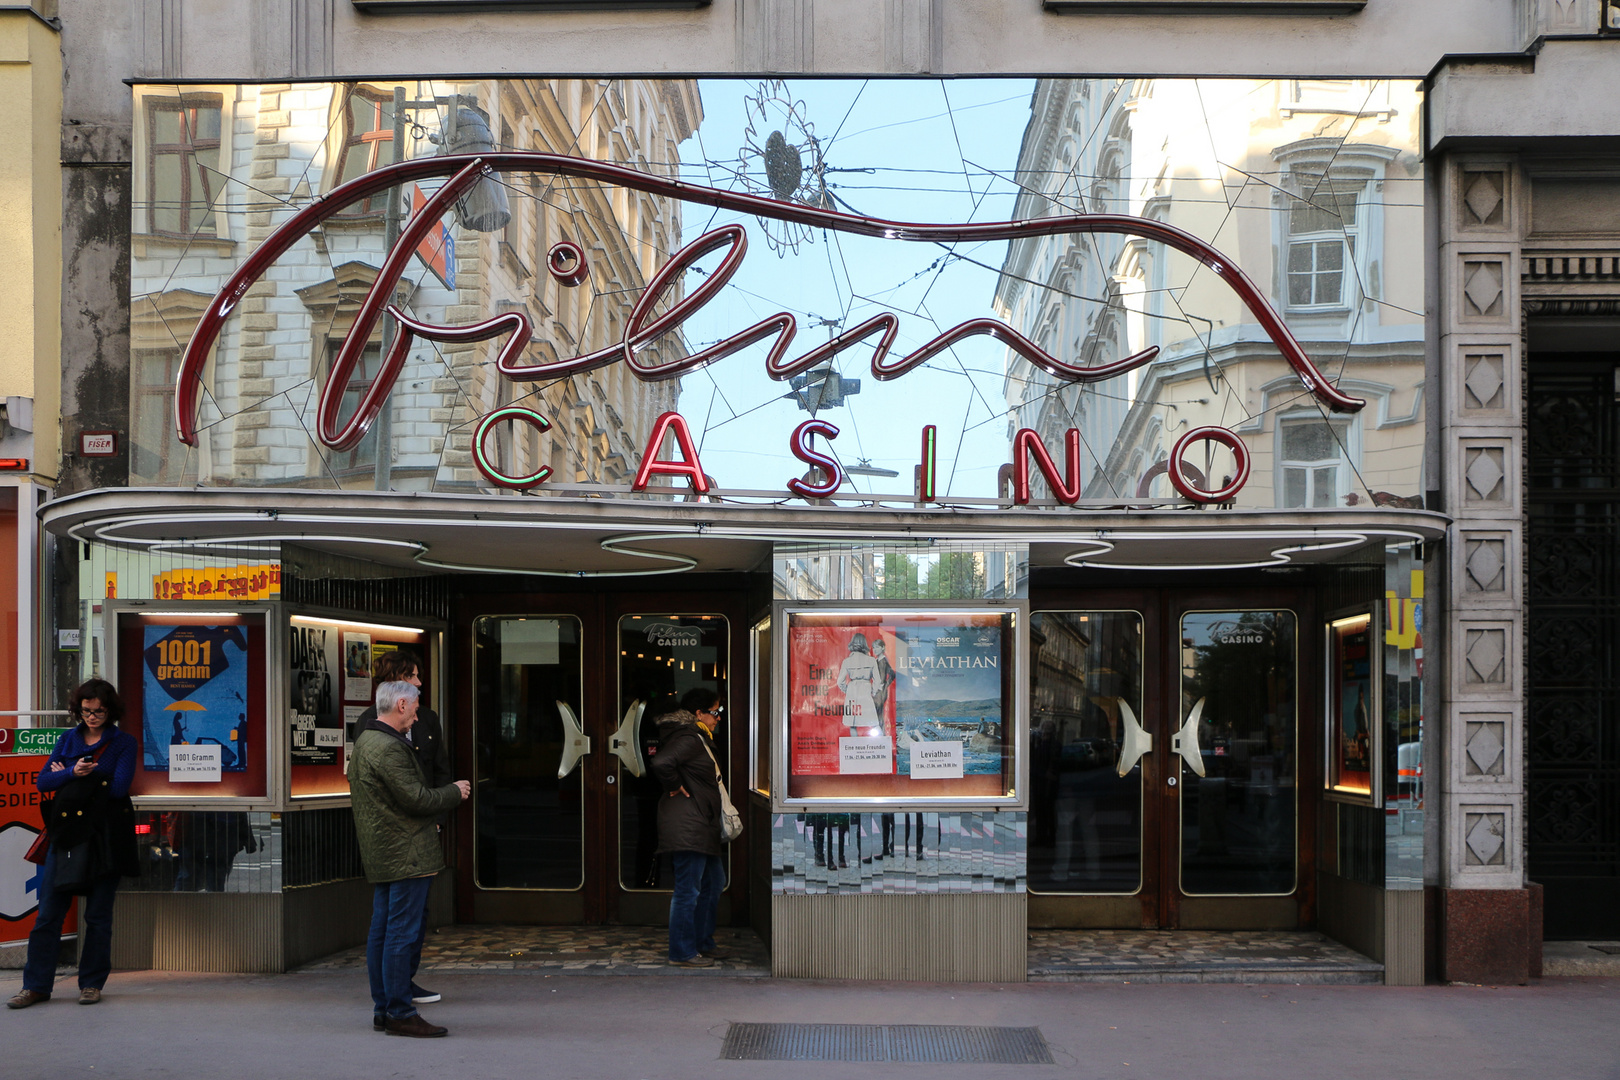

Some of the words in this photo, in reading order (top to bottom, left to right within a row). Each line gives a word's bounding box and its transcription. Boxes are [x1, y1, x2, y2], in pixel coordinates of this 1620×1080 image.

[176, 151, 1365, 448] Film
[472, 405, 1251, 506] CASINO
[657, 638, 698, 647] CASINO
[1220, 635, 1264, 644] CASINO
[156, 639, 211, 665] 1001
[898, 655, 998, 669] LEVIATHAN
[157, 665, 211, 681] gramm
[809, 664, 833, 680] Eine
[801, 684, 829, 697] neue
[814, 699, 862, 717] Freundin
[175, 753, 190, 762] 1001
[191, 753, 215, 761] Gramm
[920, 750, 952, 758] Leviathan
